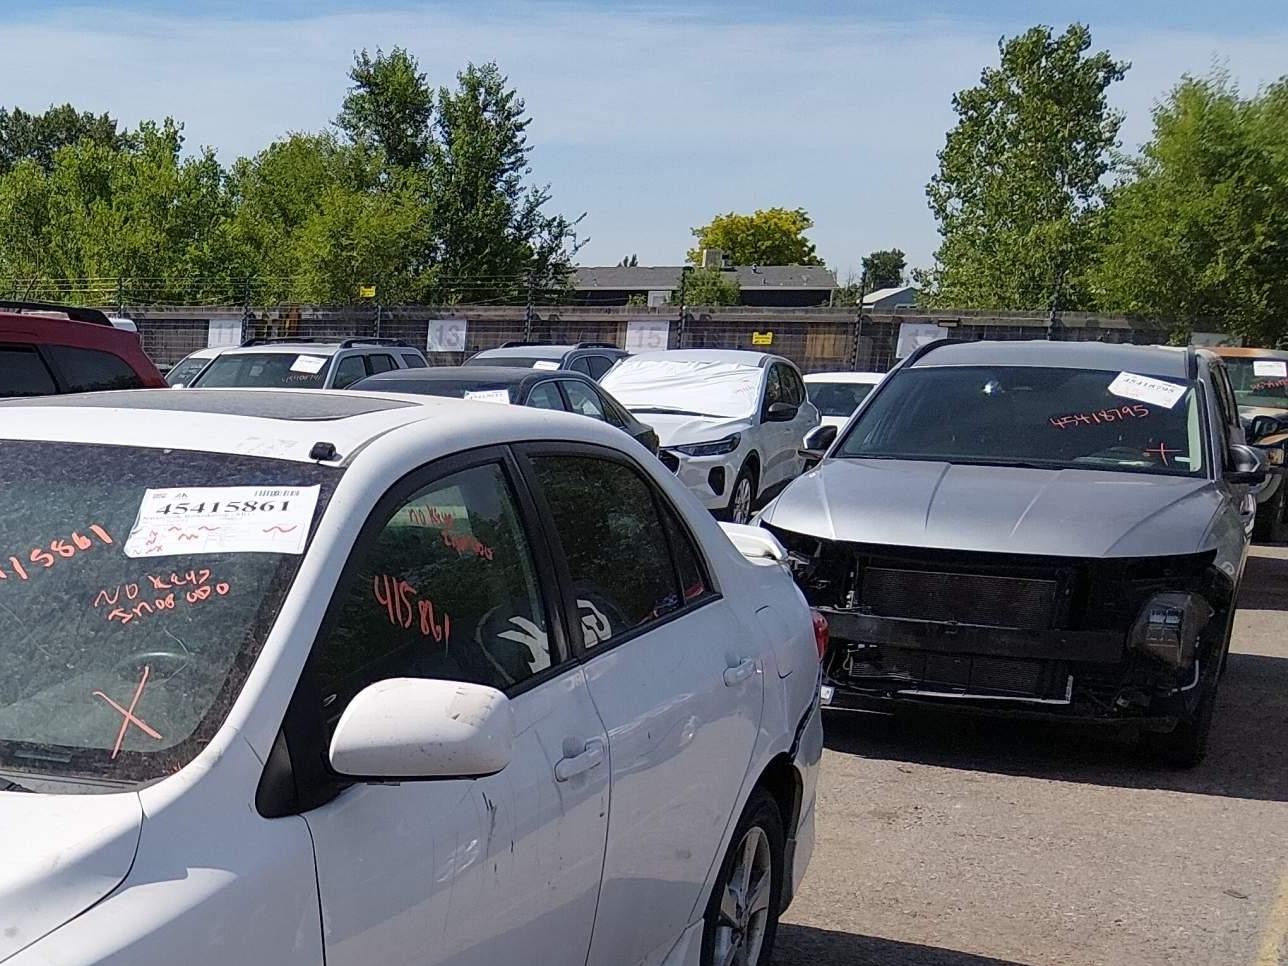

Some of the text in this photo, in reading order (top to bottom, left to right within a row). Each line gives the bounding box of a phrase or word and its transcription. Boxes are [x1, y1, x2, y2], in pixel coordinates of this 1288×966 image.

[435, 325, 460, 346] 13
[631, 325, 662, 349] 15
[1049, 404, 1150, 429] 45418795
[156, 500, 290, 515] 45415861
